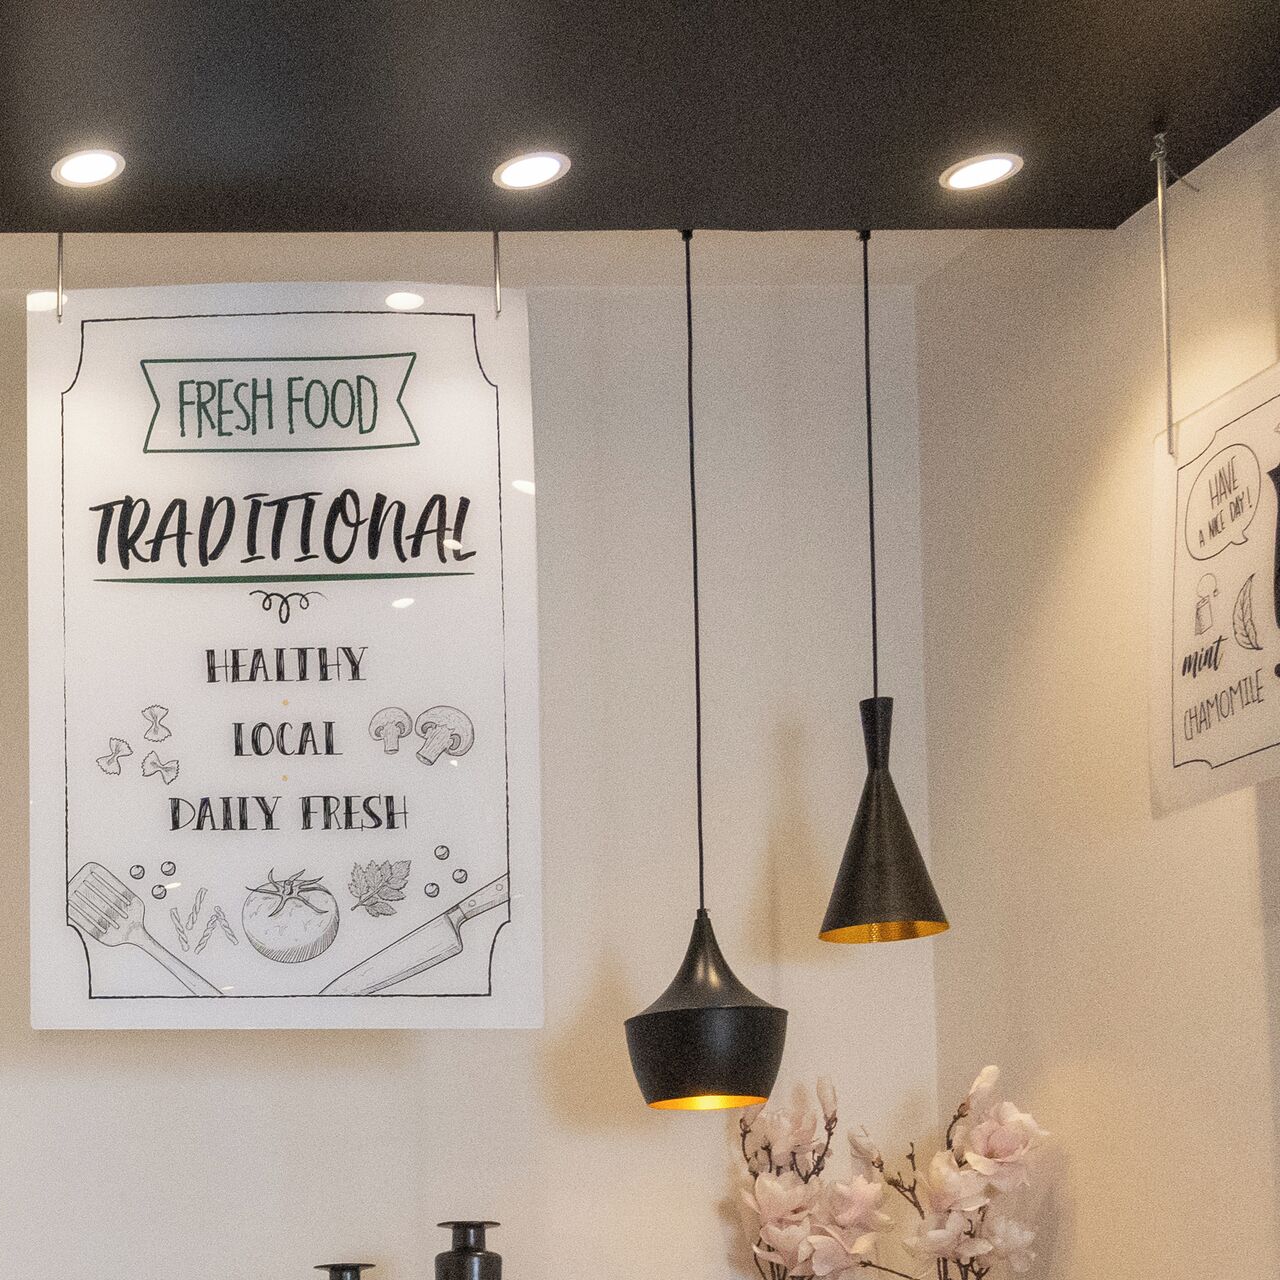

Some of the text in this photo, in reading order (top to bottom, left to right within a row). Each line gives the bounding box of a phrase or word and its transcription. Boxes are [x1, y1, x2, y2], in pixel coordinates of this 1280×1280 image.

[179, 375, 378, 438] FRESH FOOD
[1207, 455, 1239, 511] HAVE
[1198, 530, 1205, 548] A
[1207, 513, 1227, 542] NICE
[205, 646, 368, 683] HEALTHY
[1181, 635, 1229, 678] mint
[1183, 667, 1264, 741] CHAMOMILE
[232, 720, 343, 757] LOCAL
[168, 794, 409, 832] DAILY FRESH
